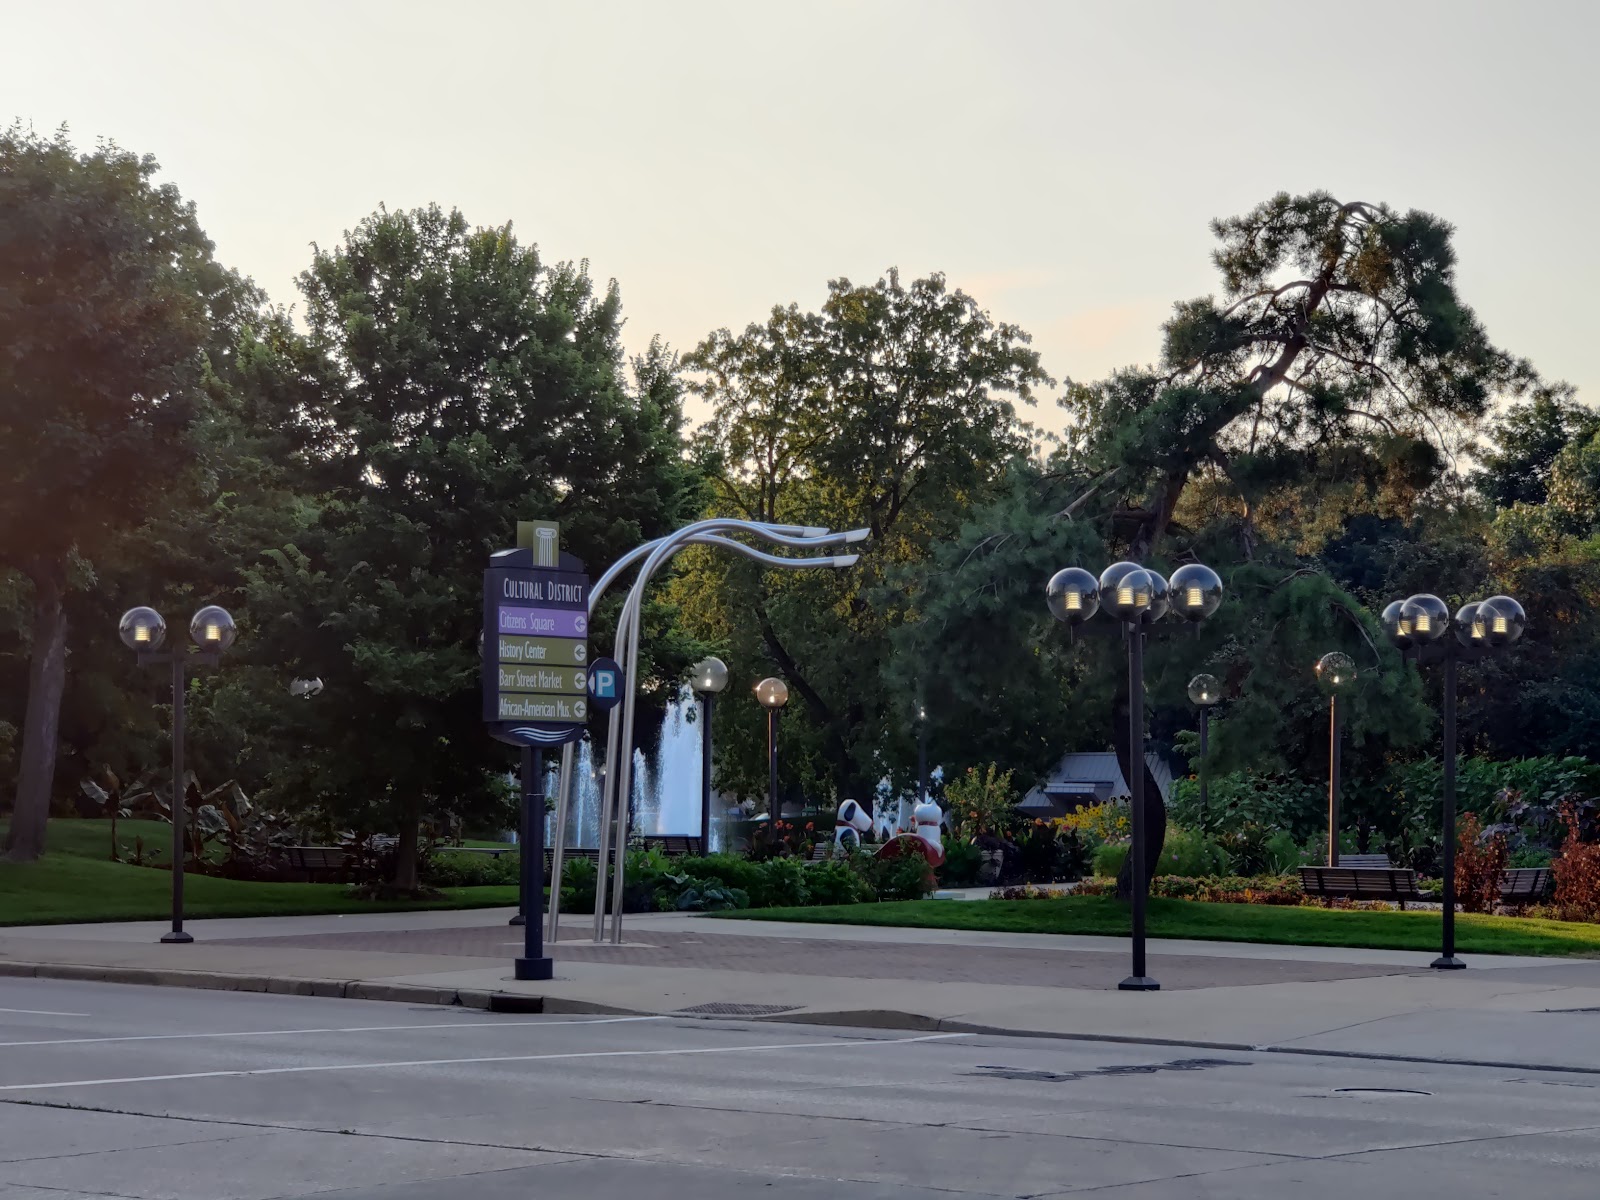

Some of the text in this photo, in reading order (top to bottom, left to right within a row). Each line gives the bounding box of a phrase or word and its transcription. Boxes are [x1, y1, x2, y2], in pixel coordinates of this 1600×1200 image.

[504, 578, 582, 603] CULTURAL DISTRICT
[500, 611, 554, 635] Citizens Square
[499, 640, 547, 660] History Center
[499, 670, 562, 689] Barr Street Market
[598, 673, 613, 694] P
[499, 699, 571, 718] African-American Mus.
